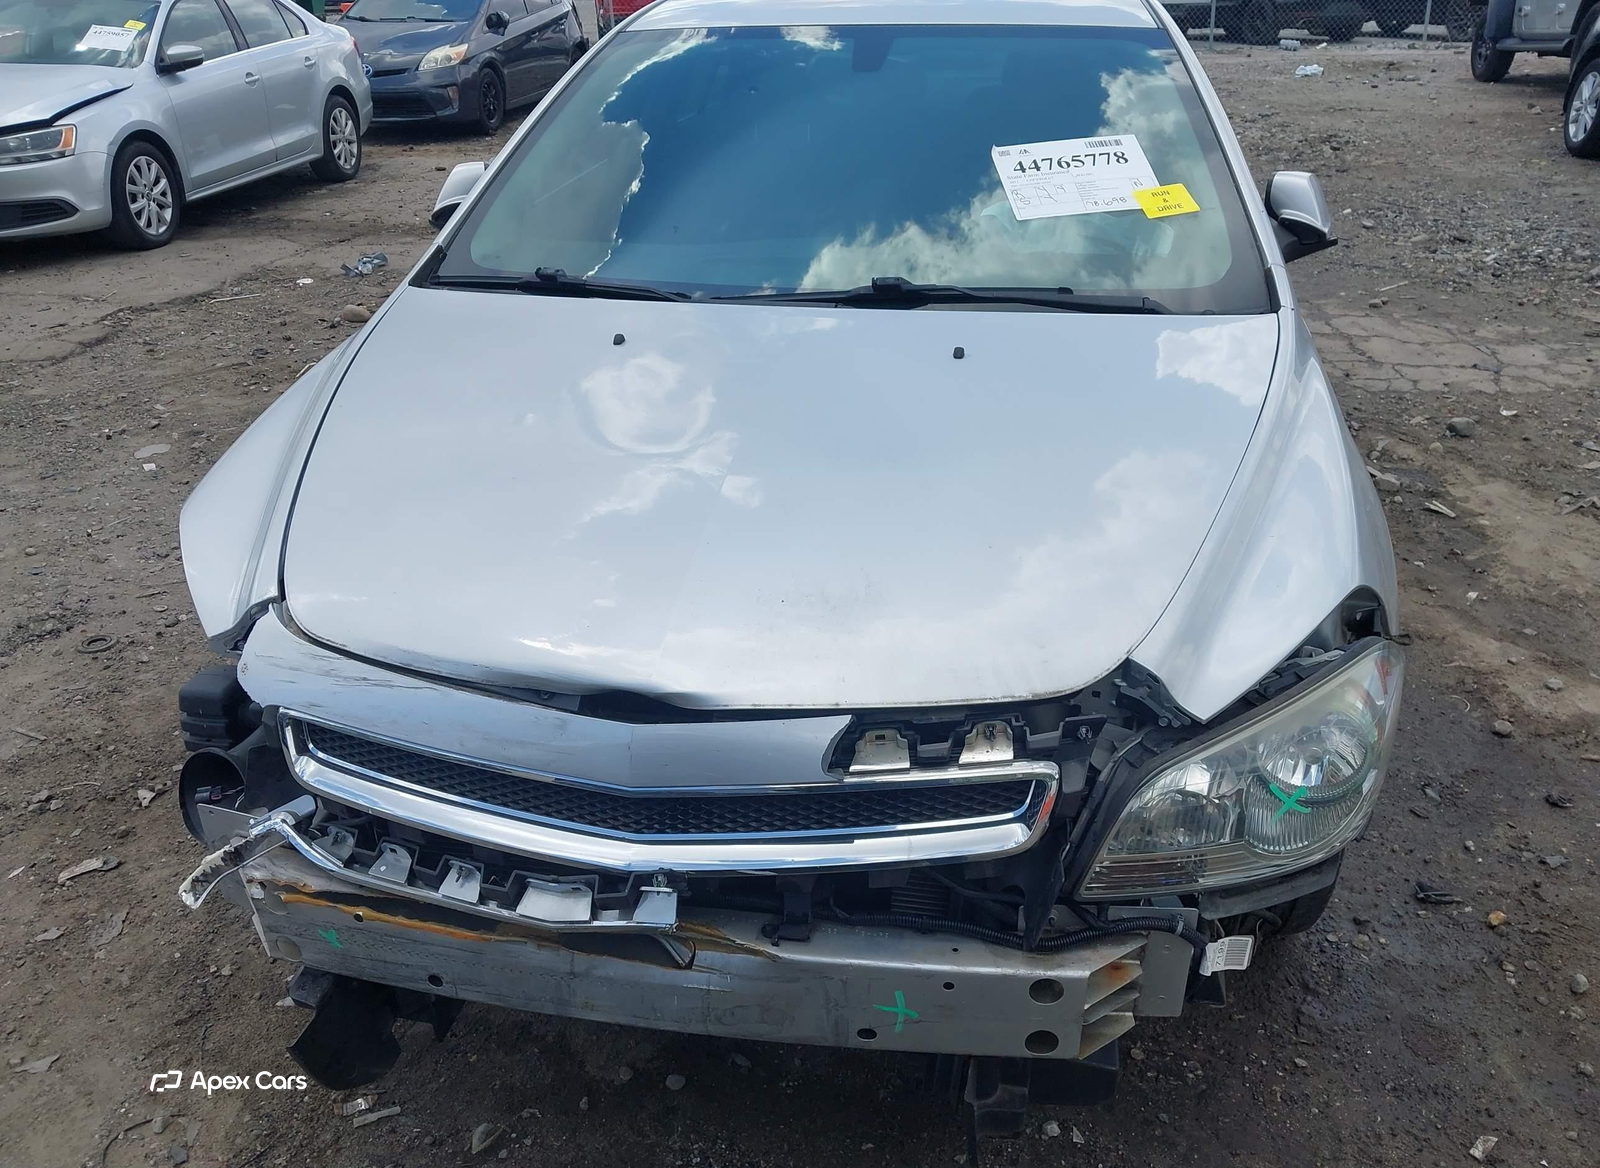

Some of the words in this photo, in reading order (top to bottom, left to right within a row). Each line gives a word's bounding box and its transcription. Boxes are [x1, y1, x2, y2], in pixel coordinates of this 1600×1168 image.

[1013, 150, 1130, 174] 44765778
[1151, 189, 1171, 198] RUN
[1157, 202, 1184, 212] DRIVE
